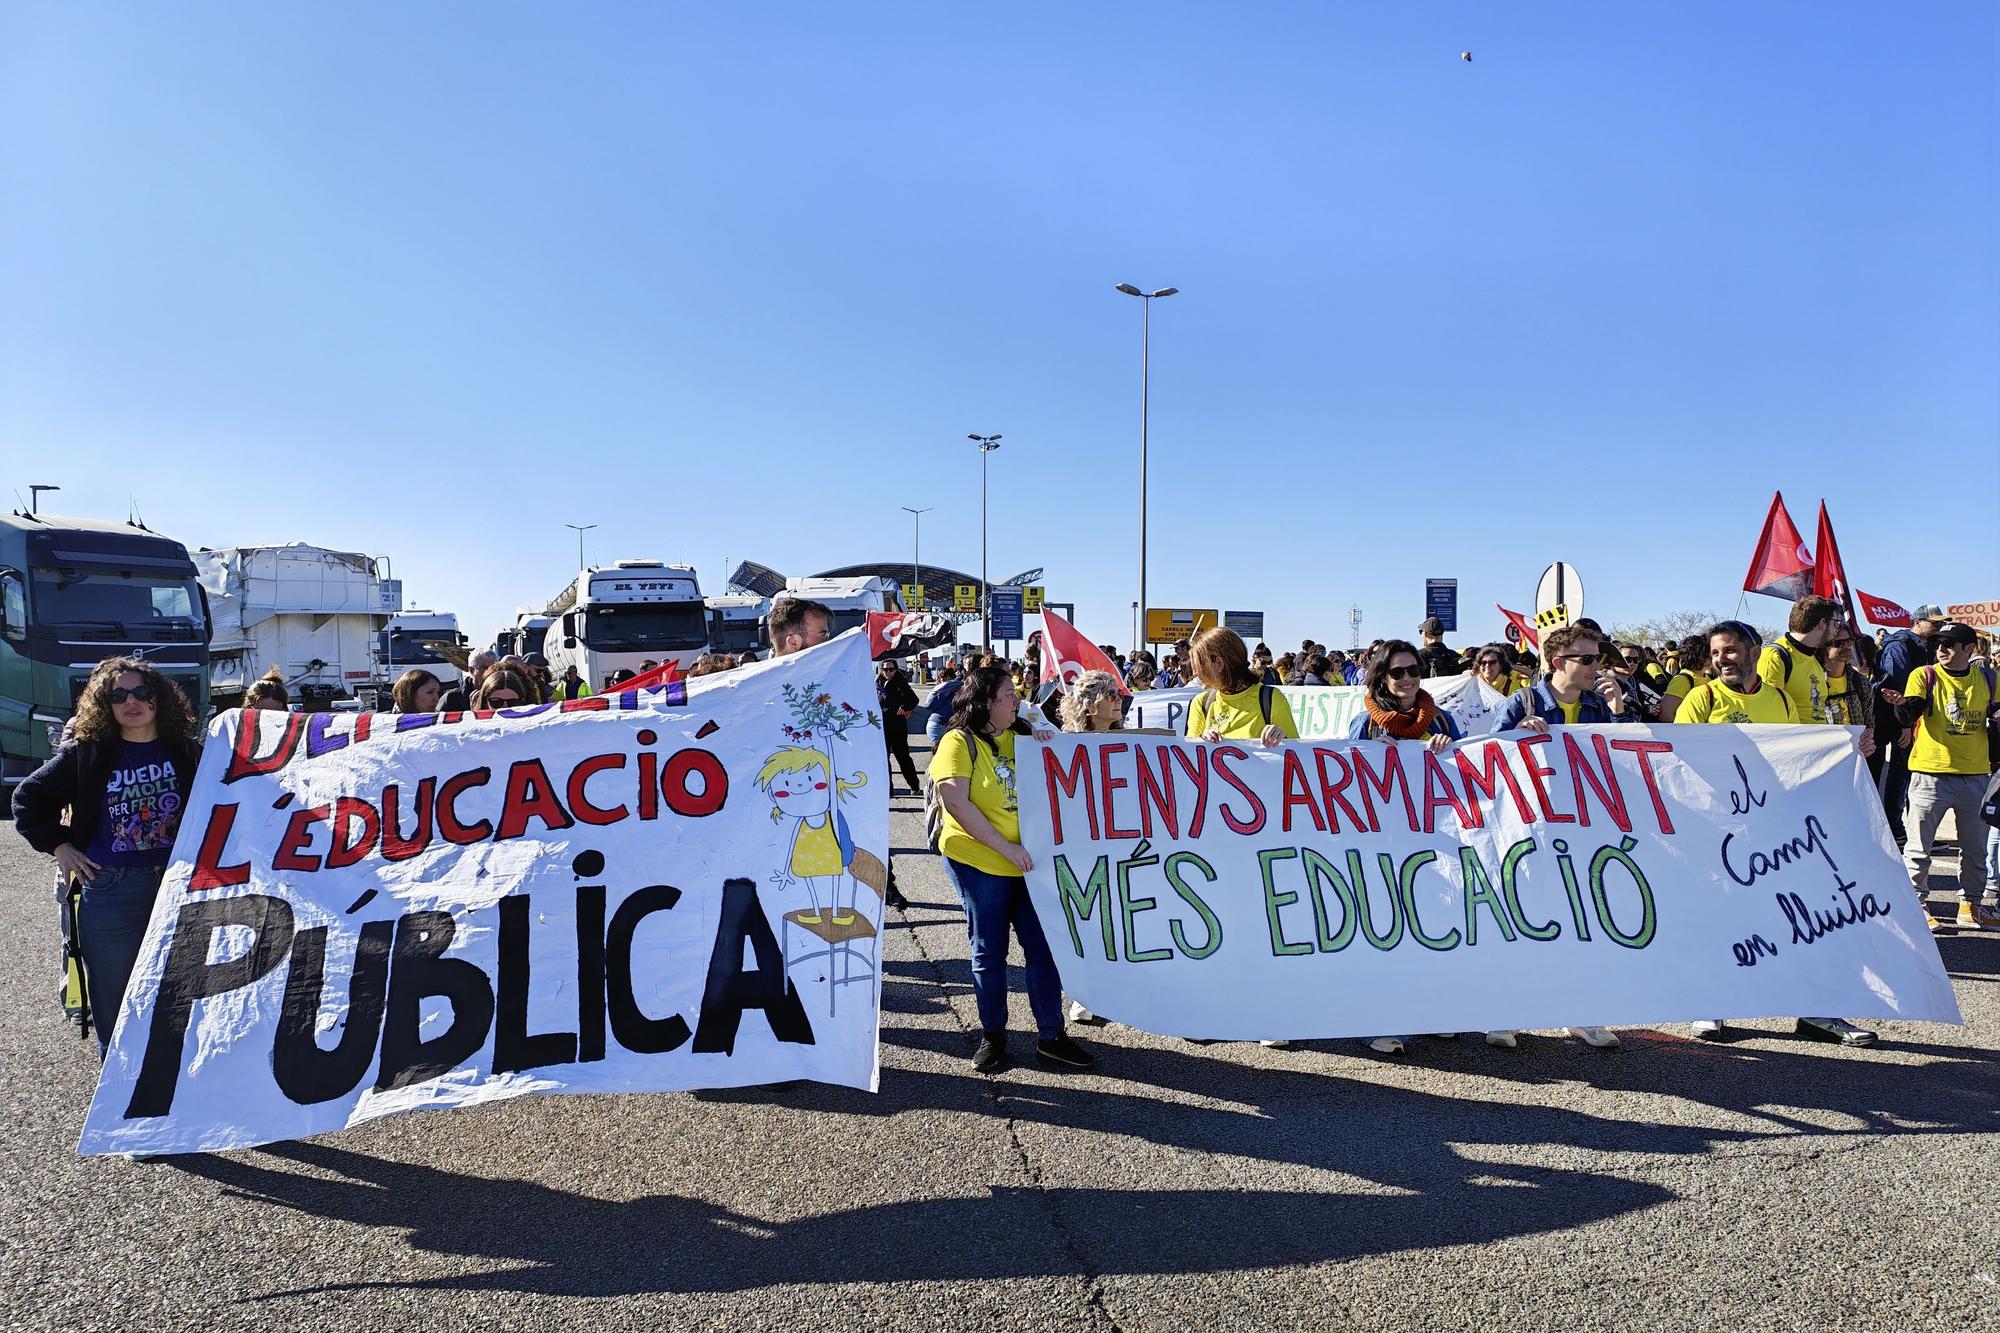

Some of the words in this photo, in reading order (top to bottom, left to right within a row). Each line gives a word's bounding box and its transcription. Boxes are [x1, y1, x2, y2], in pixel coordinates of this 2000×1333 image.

[614, 583, 633, 591] EL
[1949, 604, 1986, 615] CCOO
[107, 761, 176, 793] QUEDA
[121, 777, 177, 801] MOLT
[1042, 743, 1266, 845] MENYS
[1282, 739, 1674, 837] ARMAMENT
[1730, 754, 1767, 815] el
[108, 803, 129, 819] PER
[131, 796, 157, 813] FER
[1721, 815, 1838, 886] Camp
[1053, 838, 1224, 963] MÉS
[1732, 933, 1778, 967] en
[1775, 873, 1891, 944] lluita
